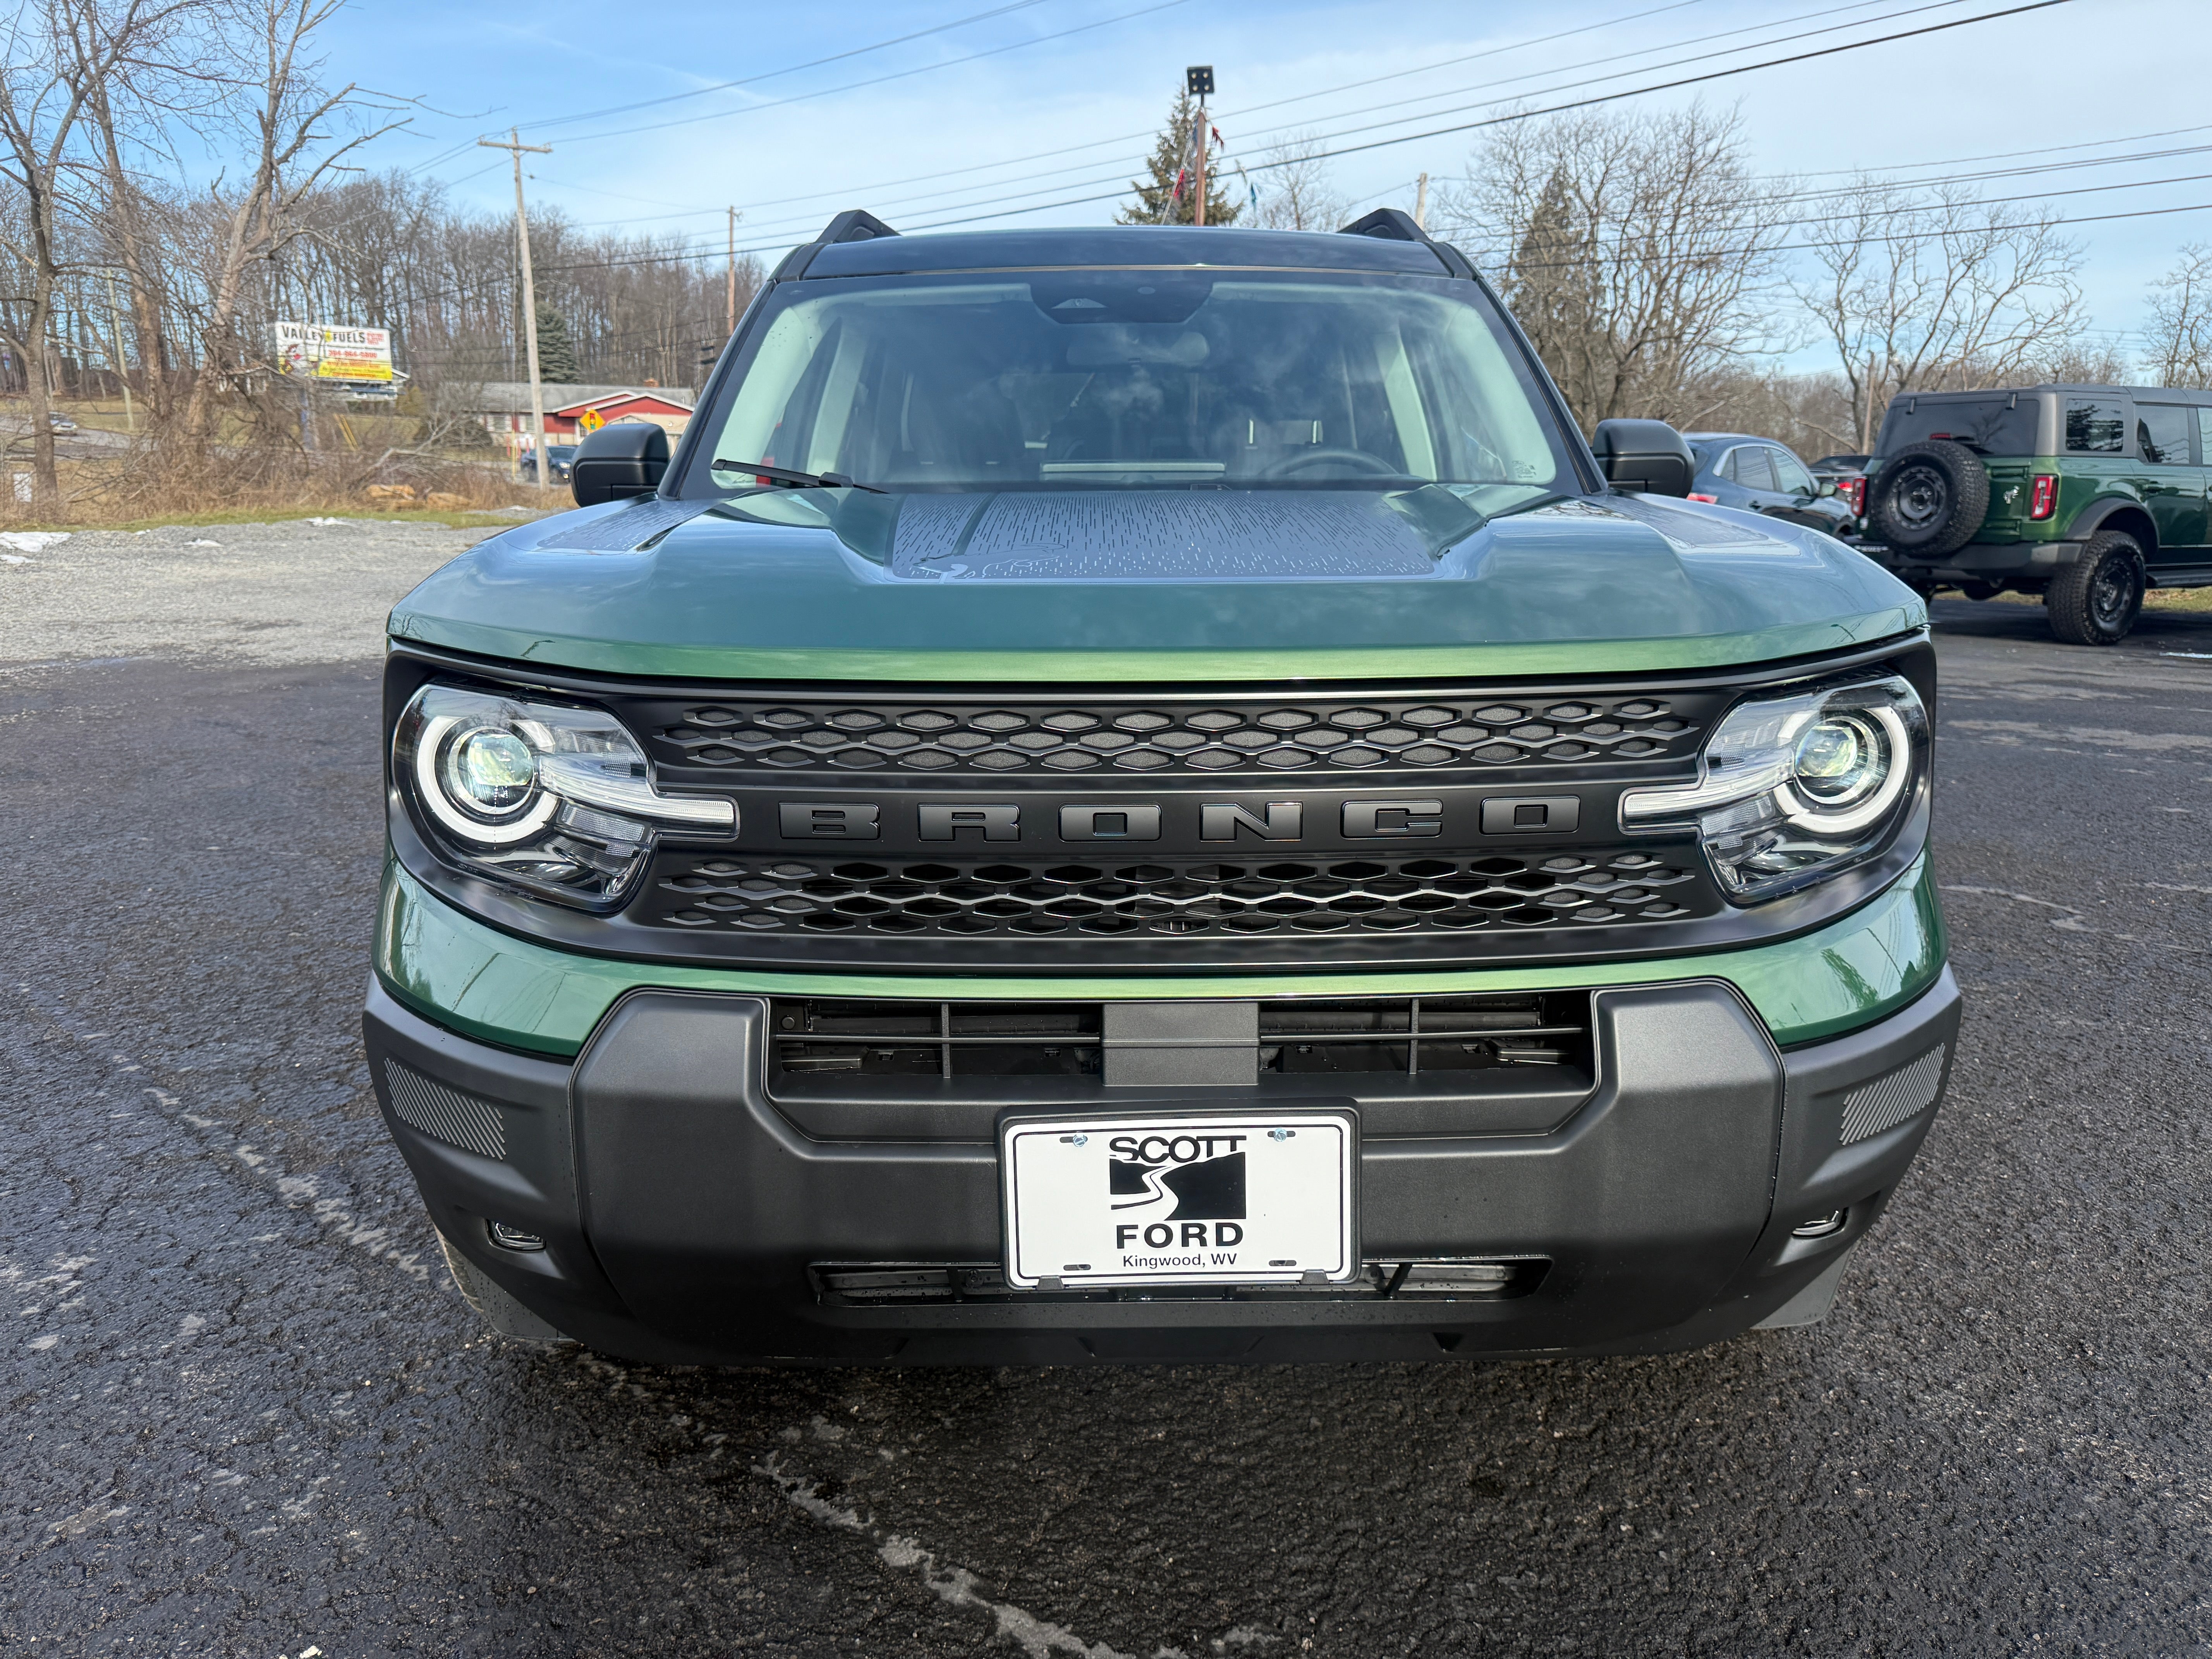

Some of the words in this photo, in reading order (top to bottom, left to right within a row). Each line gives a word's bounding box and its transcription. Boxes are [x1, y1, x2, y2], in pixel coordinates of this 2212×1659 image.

[282, 325, 324, 341] VALLE
[333, 332, 365, 343] FUELS
[779, 794, 1580, 842] BRONCO
[1109, 1135, 1247, 1163] SCOTT
[1116, 1222, 1243, 1249] FORD
[1123, 1254, 1206, 1269] Kingwood,
[1211, 1253, 1237, 1265] WV
